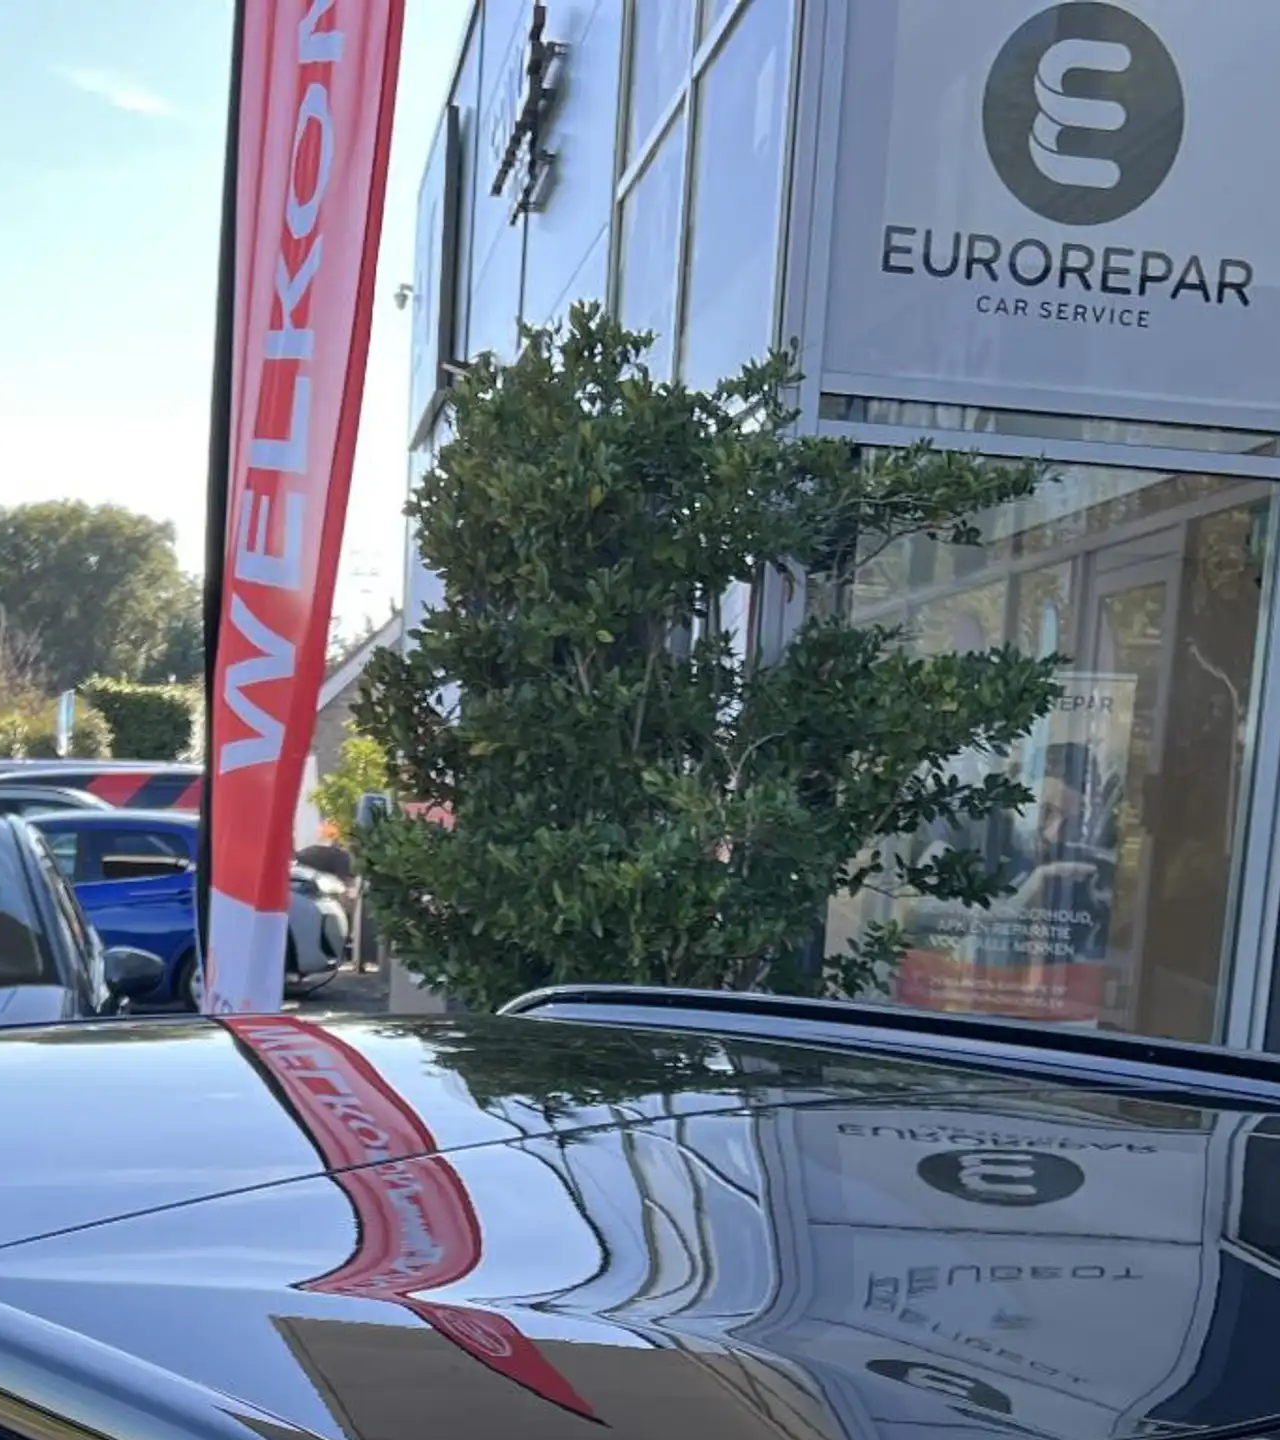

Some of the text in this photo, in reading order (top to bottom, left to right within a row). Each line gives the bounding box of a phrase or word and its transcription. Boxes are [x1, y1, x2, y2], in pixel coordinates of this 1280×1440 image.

[881, 224, 1254, 307] EUROREPAR
[976, 295, 1151, 329] CAR SERVICE
